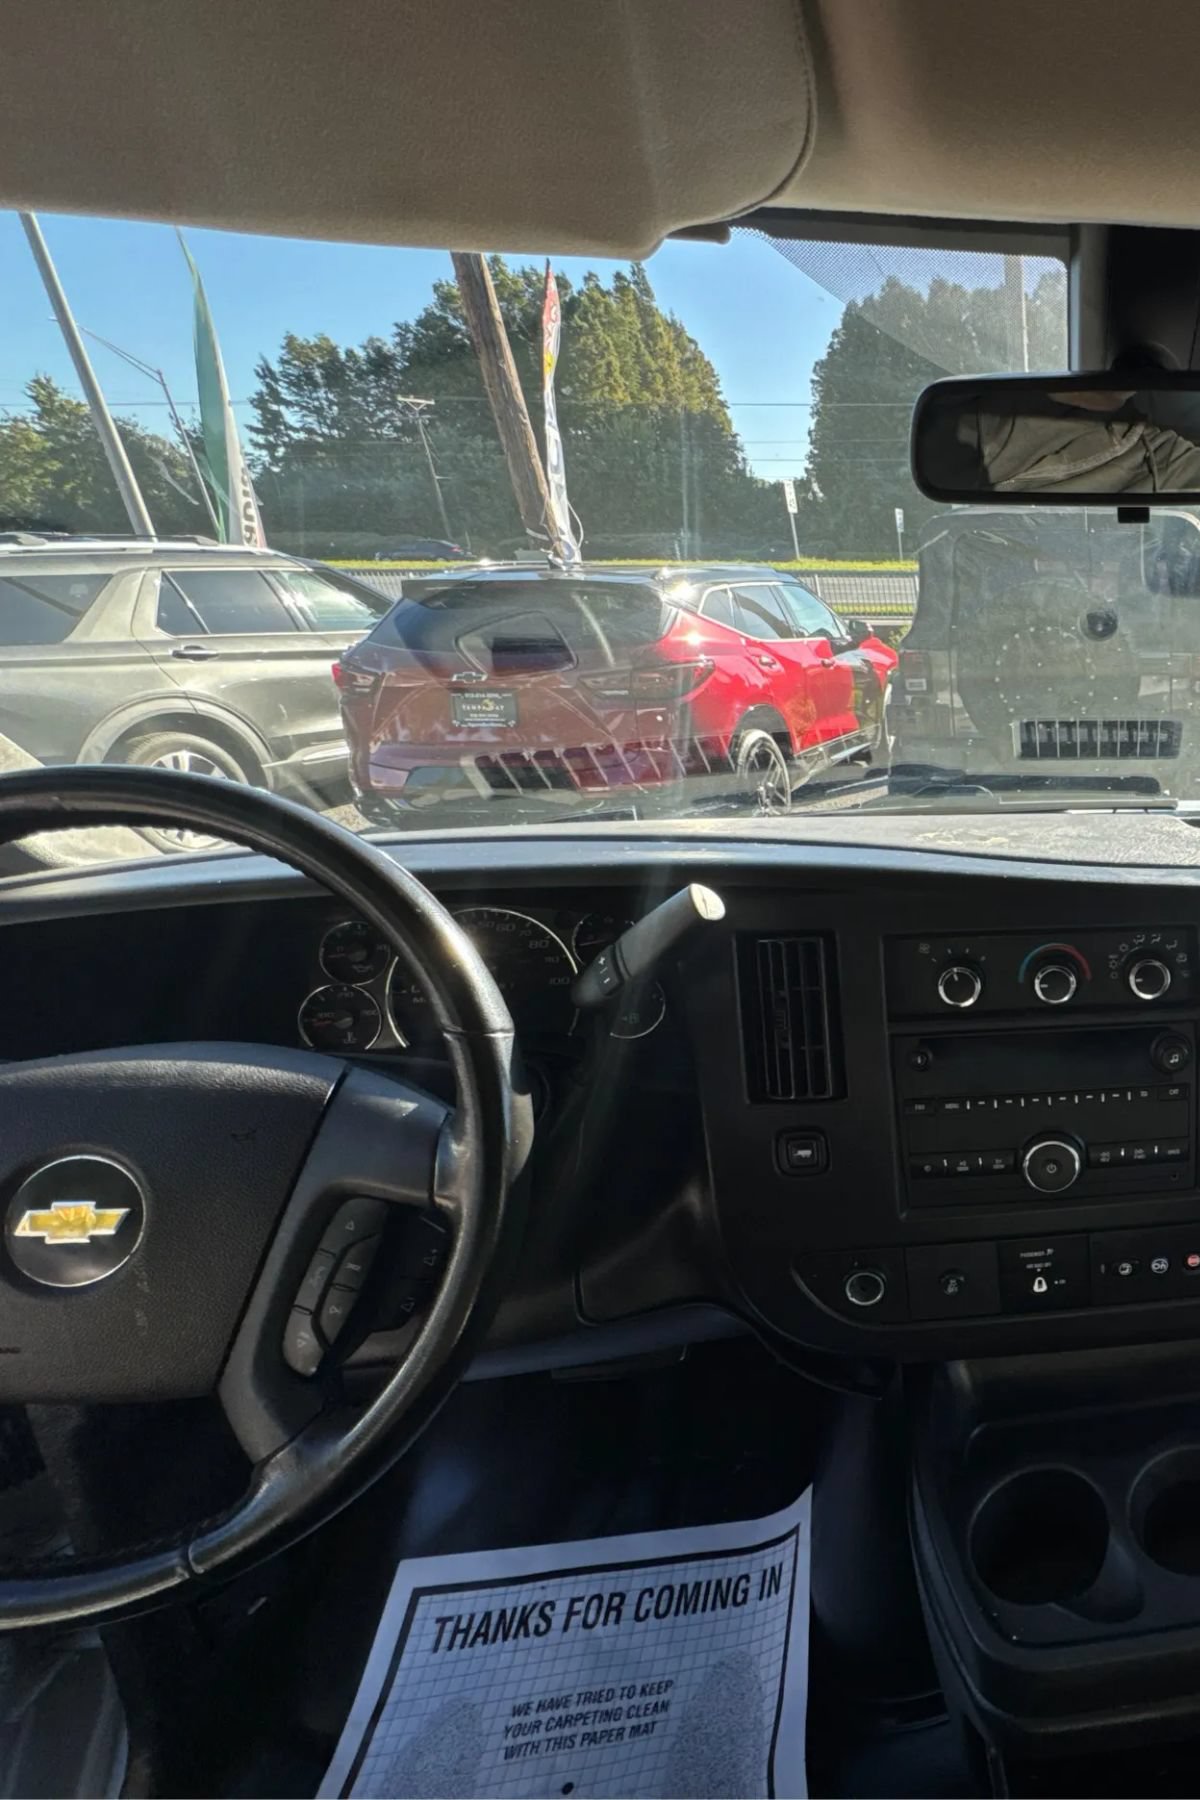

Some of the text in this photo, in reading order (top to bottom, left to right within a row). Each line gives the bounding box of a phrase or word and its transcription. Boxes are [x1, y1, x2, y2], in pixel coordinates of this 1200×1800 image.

[432, 1562, 784, 1655] THANKS FOR COMING IN
[511, 1680, 674, 1718] WE HAVE TRIED TO KEEP
[504, 1699, 670, 1740] YOUR CARPETING CLEAN
[504, 1721, 659, 1760] WITH THIS PAPER MAT
